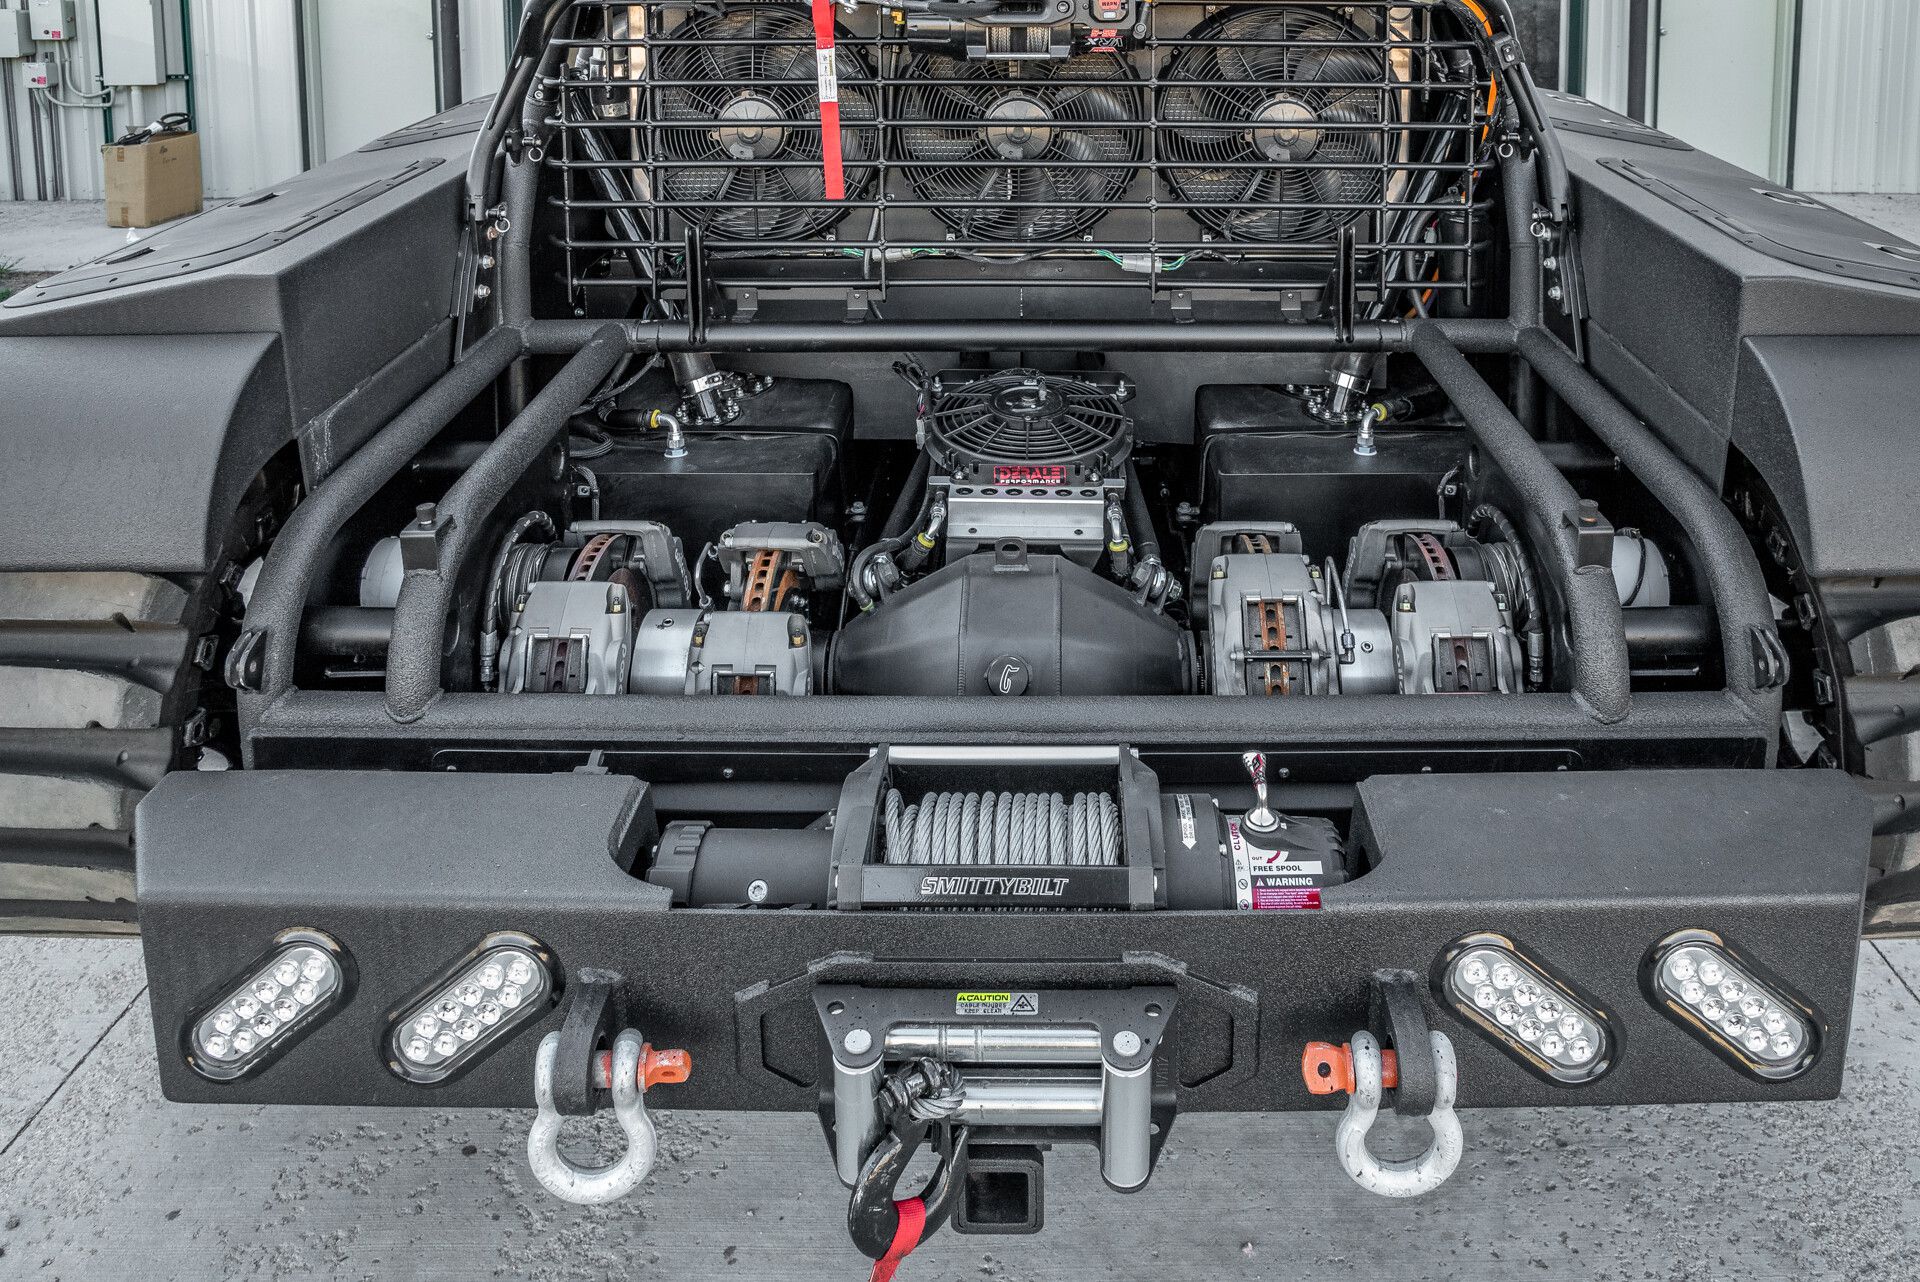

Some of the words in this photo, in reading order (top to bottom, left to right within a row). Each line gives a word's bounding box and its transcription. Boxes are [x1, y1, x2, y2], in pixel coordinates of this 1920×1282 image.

[1000, 465, 1060, 479] DERALE
[921, 877, 1069, 896] SMITTYBILT
[1266, 877, 1314, 887] WARNING
